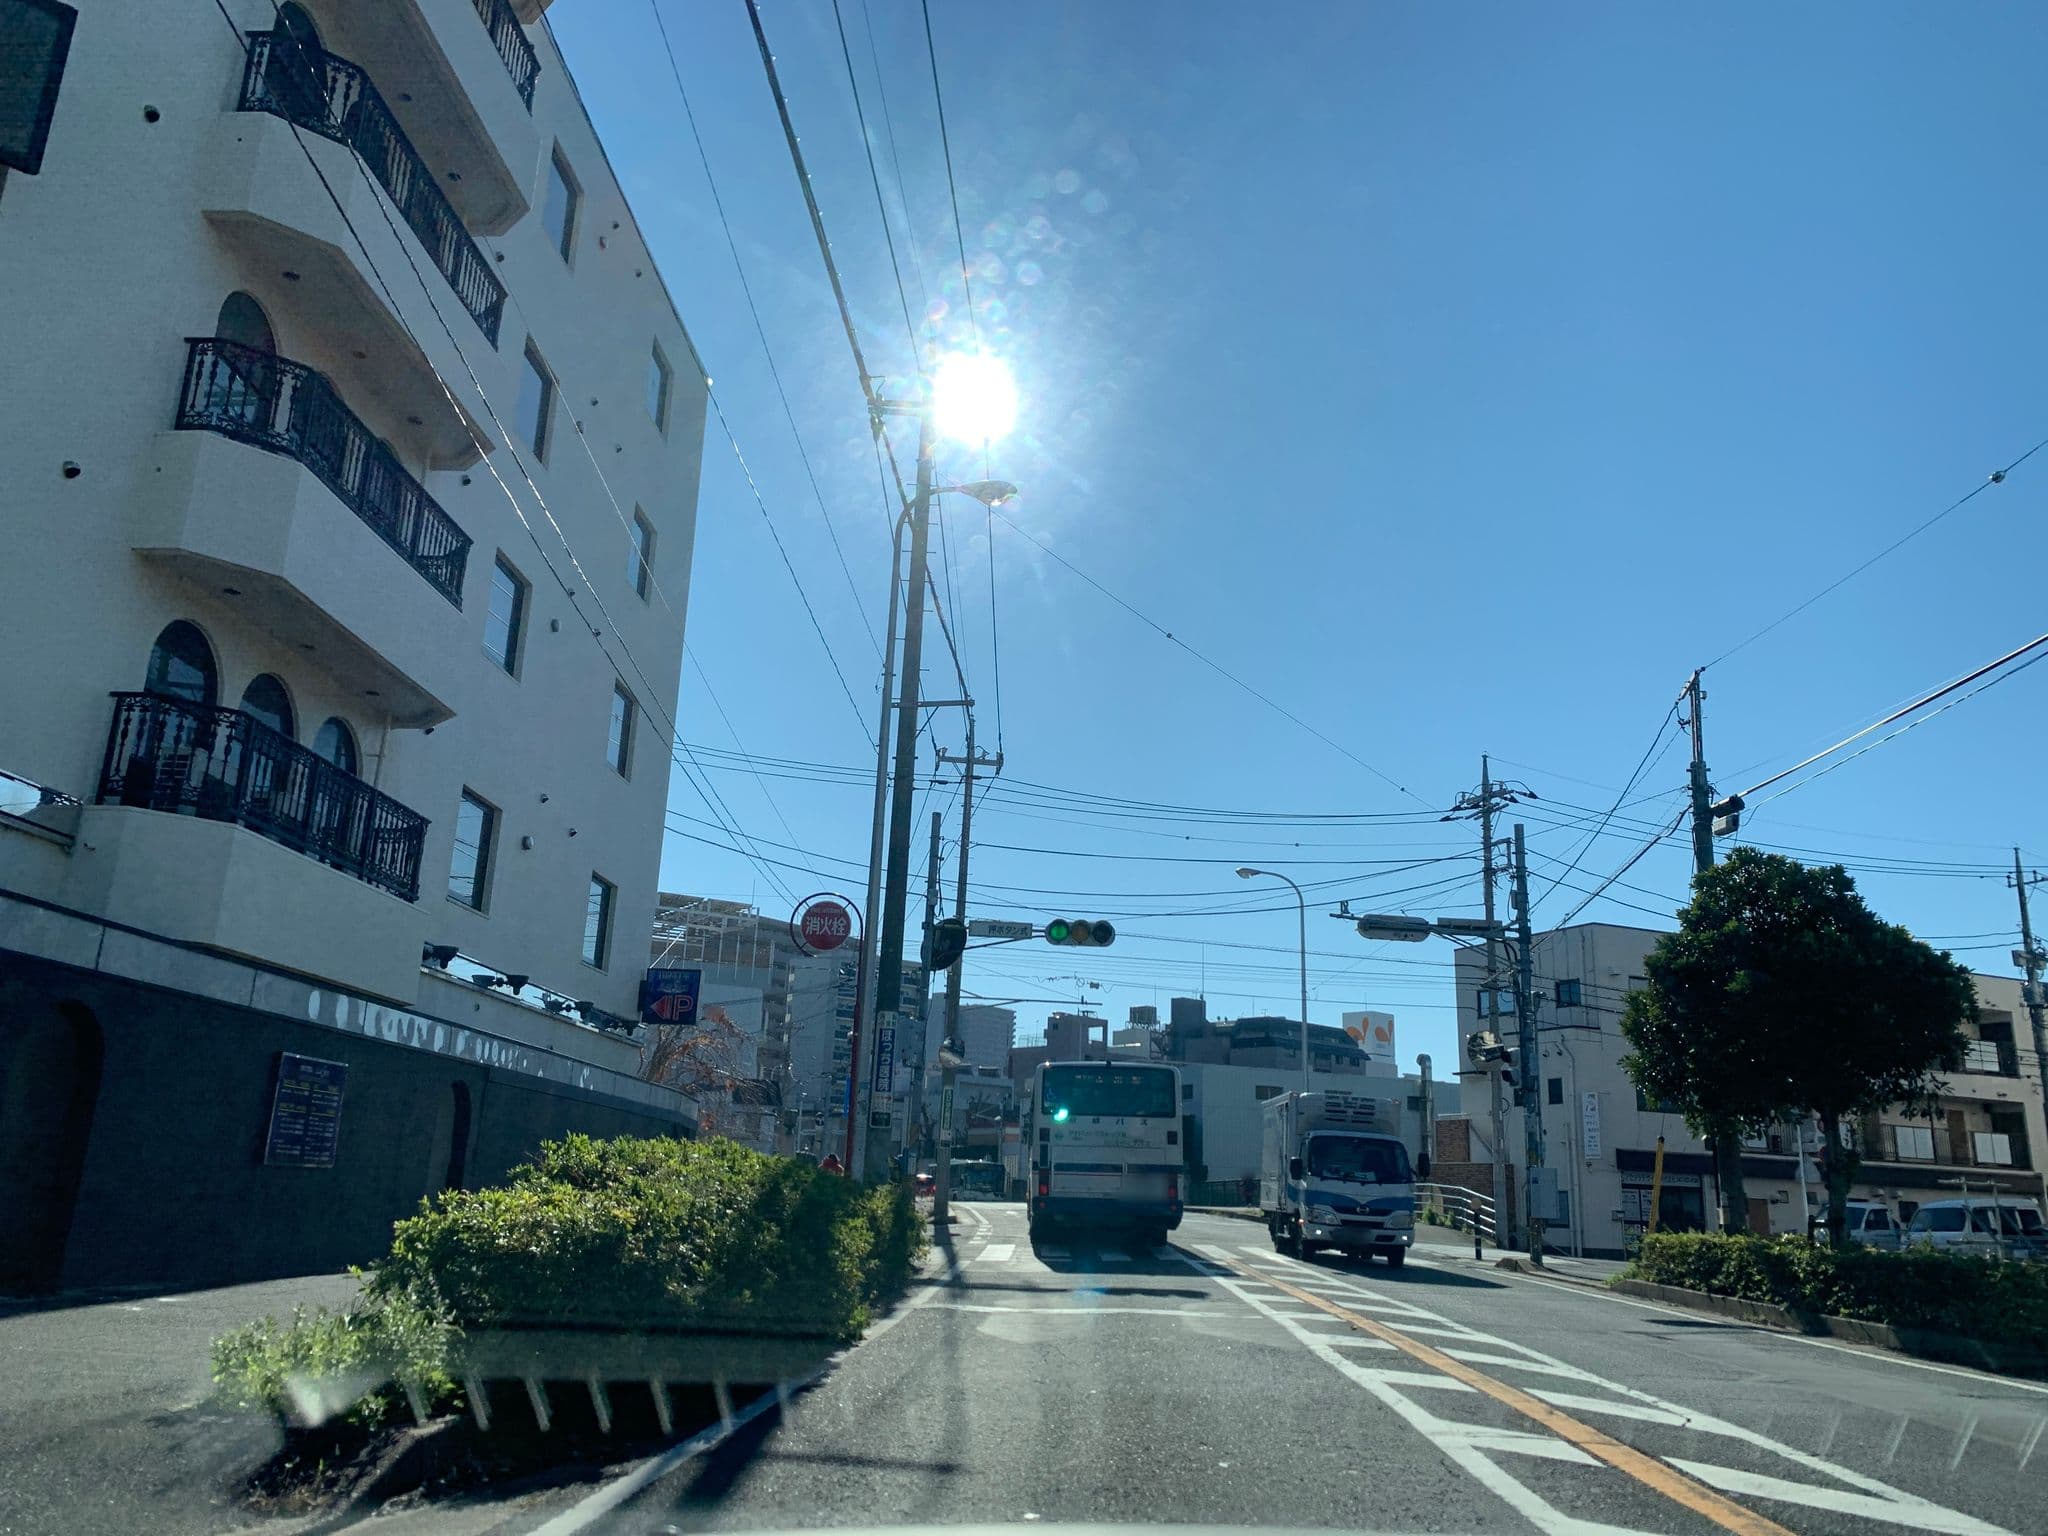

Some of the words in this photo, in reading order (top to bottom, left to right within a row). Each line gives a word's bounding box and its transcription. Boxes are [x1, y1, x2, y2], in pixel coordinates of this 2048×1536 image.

[805, 916, 847, 936] 消火栓
[673, 994, 694, 1021] P
